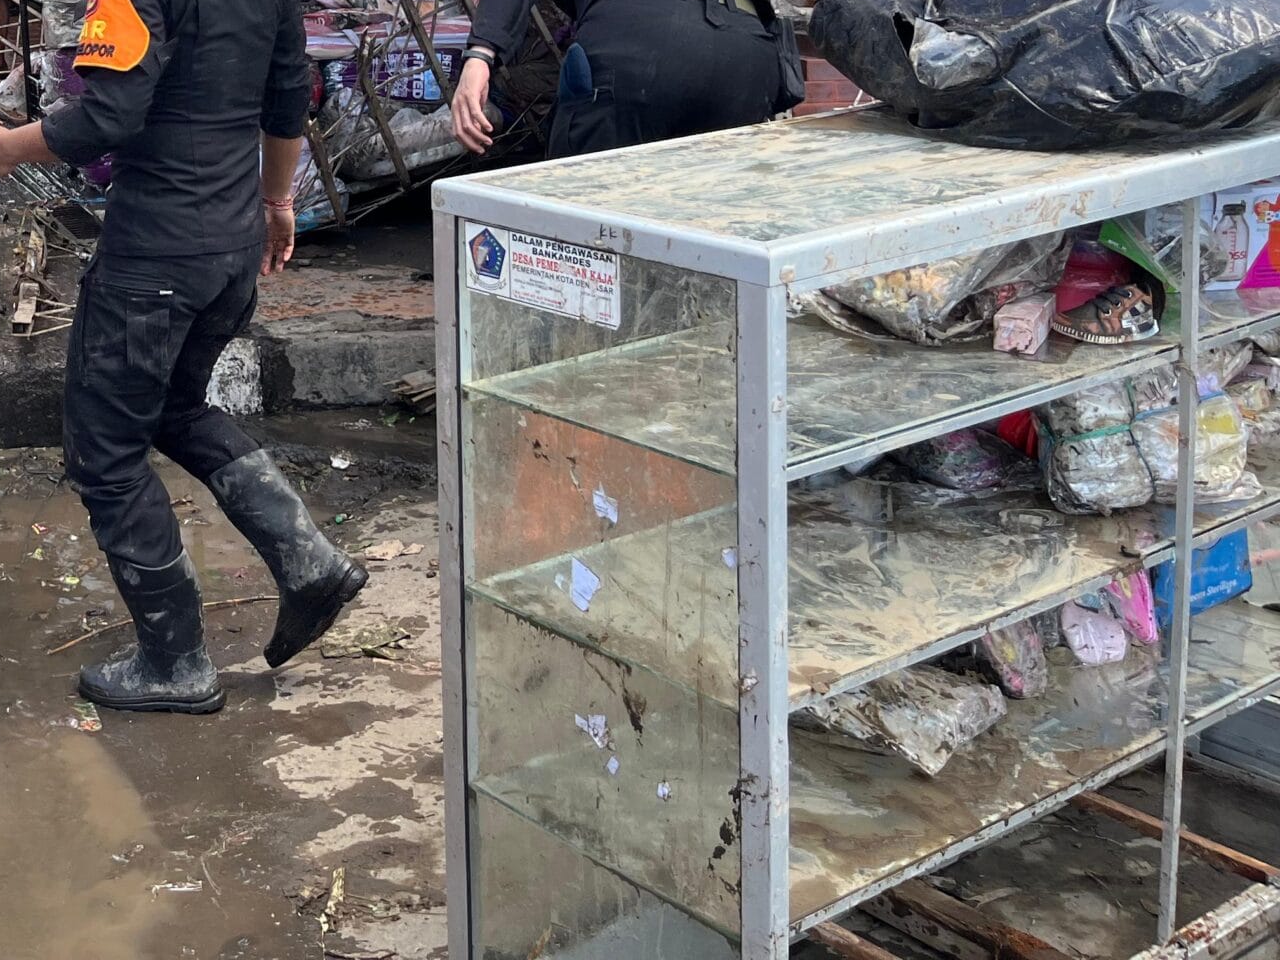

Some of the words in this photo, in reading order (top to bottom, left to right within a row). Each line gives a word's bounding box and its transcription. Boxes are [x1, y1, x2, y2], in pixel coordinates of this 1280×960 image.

[512, 233, 543, 248] DALAM
[545, 241, 613, 263] PENGAWASAN
[532, 247, 591, 268] BANKAMDES
[512, 252, 534, 265] DESA
[535, 257, 587, 279] PEMEAN
[590, 269, 613, 286] KAJA
[512, 263, 554, 280] PEMERINTAH
[556, 273, 574, 285] KOTA
[575, 279, 614, 295] DENSAR
